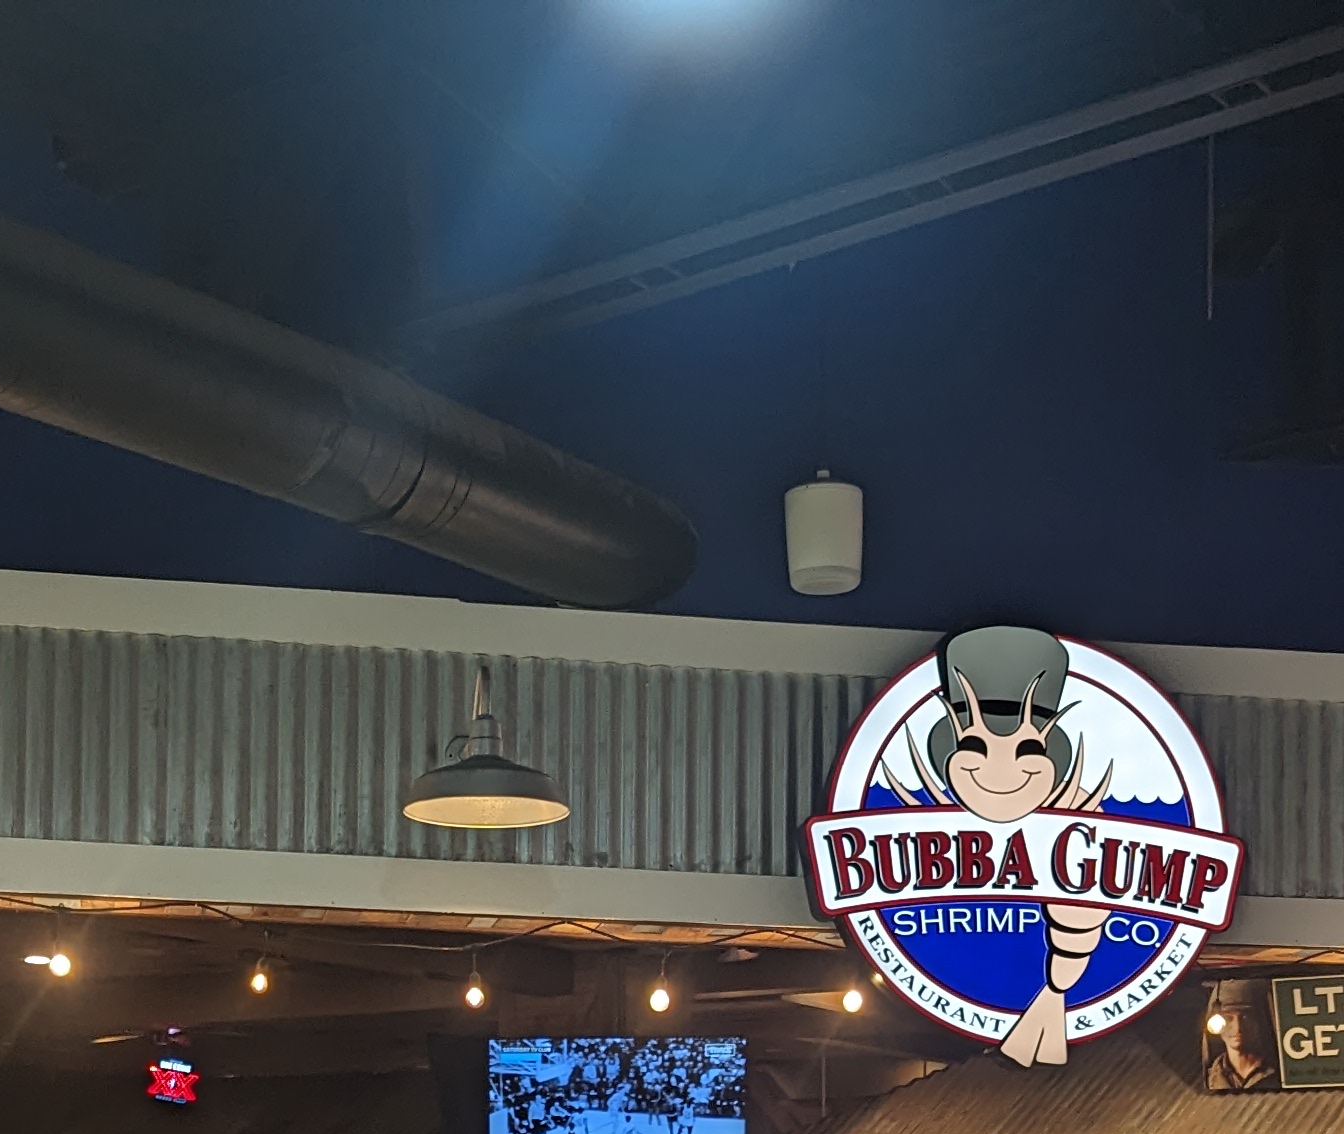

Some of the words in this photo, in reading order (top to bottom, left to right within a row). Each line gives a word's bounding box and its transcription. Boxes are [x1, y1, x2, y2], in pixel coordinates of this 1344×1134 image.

[824, 826, 1037, 900] BUBBA
[1051, 822, 1228, 912] GUMP
[893, 908, 1041, 936] SHRIMP
[1104, 916, 1162, 948] CO.
[859, 916, 1006, 1033] RESTAURANT
[1074, 1014, 1095, 1031] &
[1103, 933, 1193, 1022] MARKET
